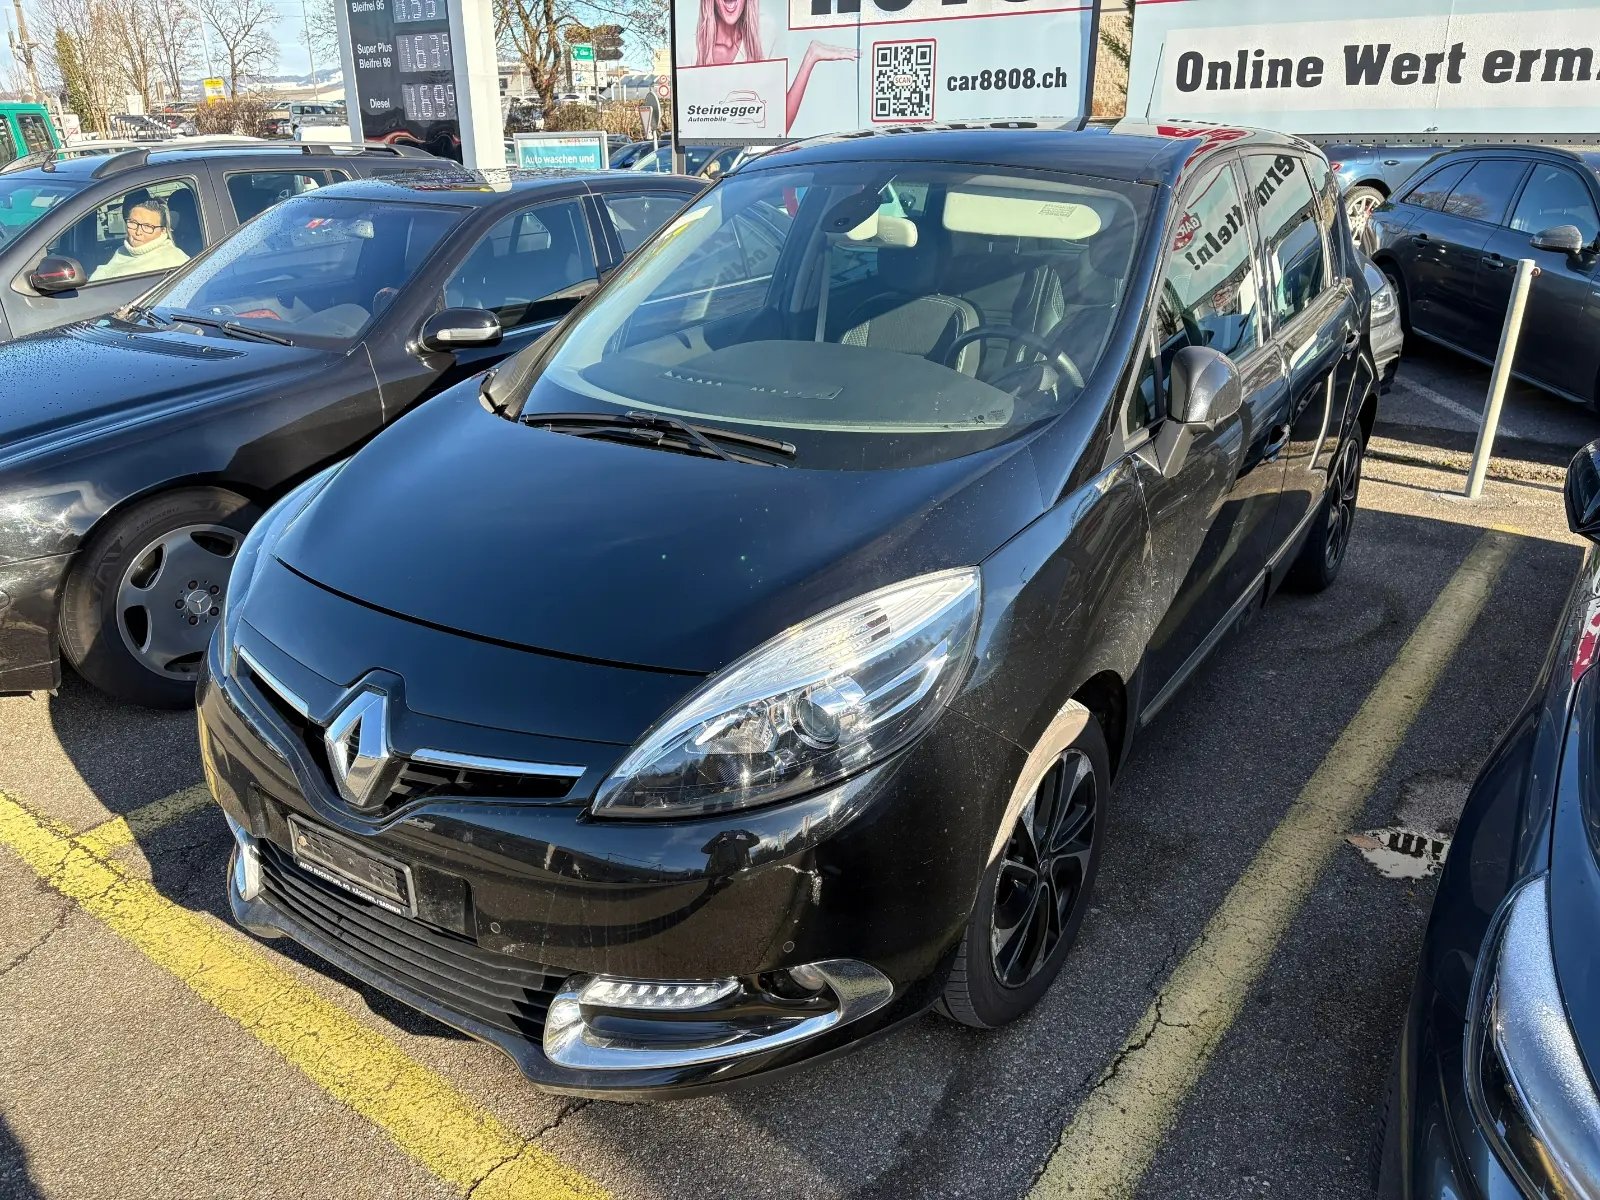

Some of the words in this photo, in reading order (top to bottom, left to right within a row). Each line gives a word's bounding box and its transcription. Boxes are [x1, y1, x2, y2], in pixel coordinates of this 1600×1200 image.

[352, 1, 376, 12] Bleifrei
[376, 0, 385, 10] 95
[357, 43, 376, 55] Super
[377, 42, 393, 53] Plus
[359, 57, 382, 69] Bleifrei
[382, 57, 392, 67] 98
[1176, 48, 1324, 93] Online
[1343, 42, 1466, 86] Wert
[1481, 46, 1600, 83] erm
[895, 75, 911, 84] SCAN
[946, 66, 1068, 92] car8808.ch
[369, 97, 391, 108] Diesel
[687, 105, 763, 117] Steinegger
[525, 154, 543, 164] Auto
[543, 153, 578, 164] waschen
[578, 152, 595, 163] und
[299, 861, 314, 873] AUTO
